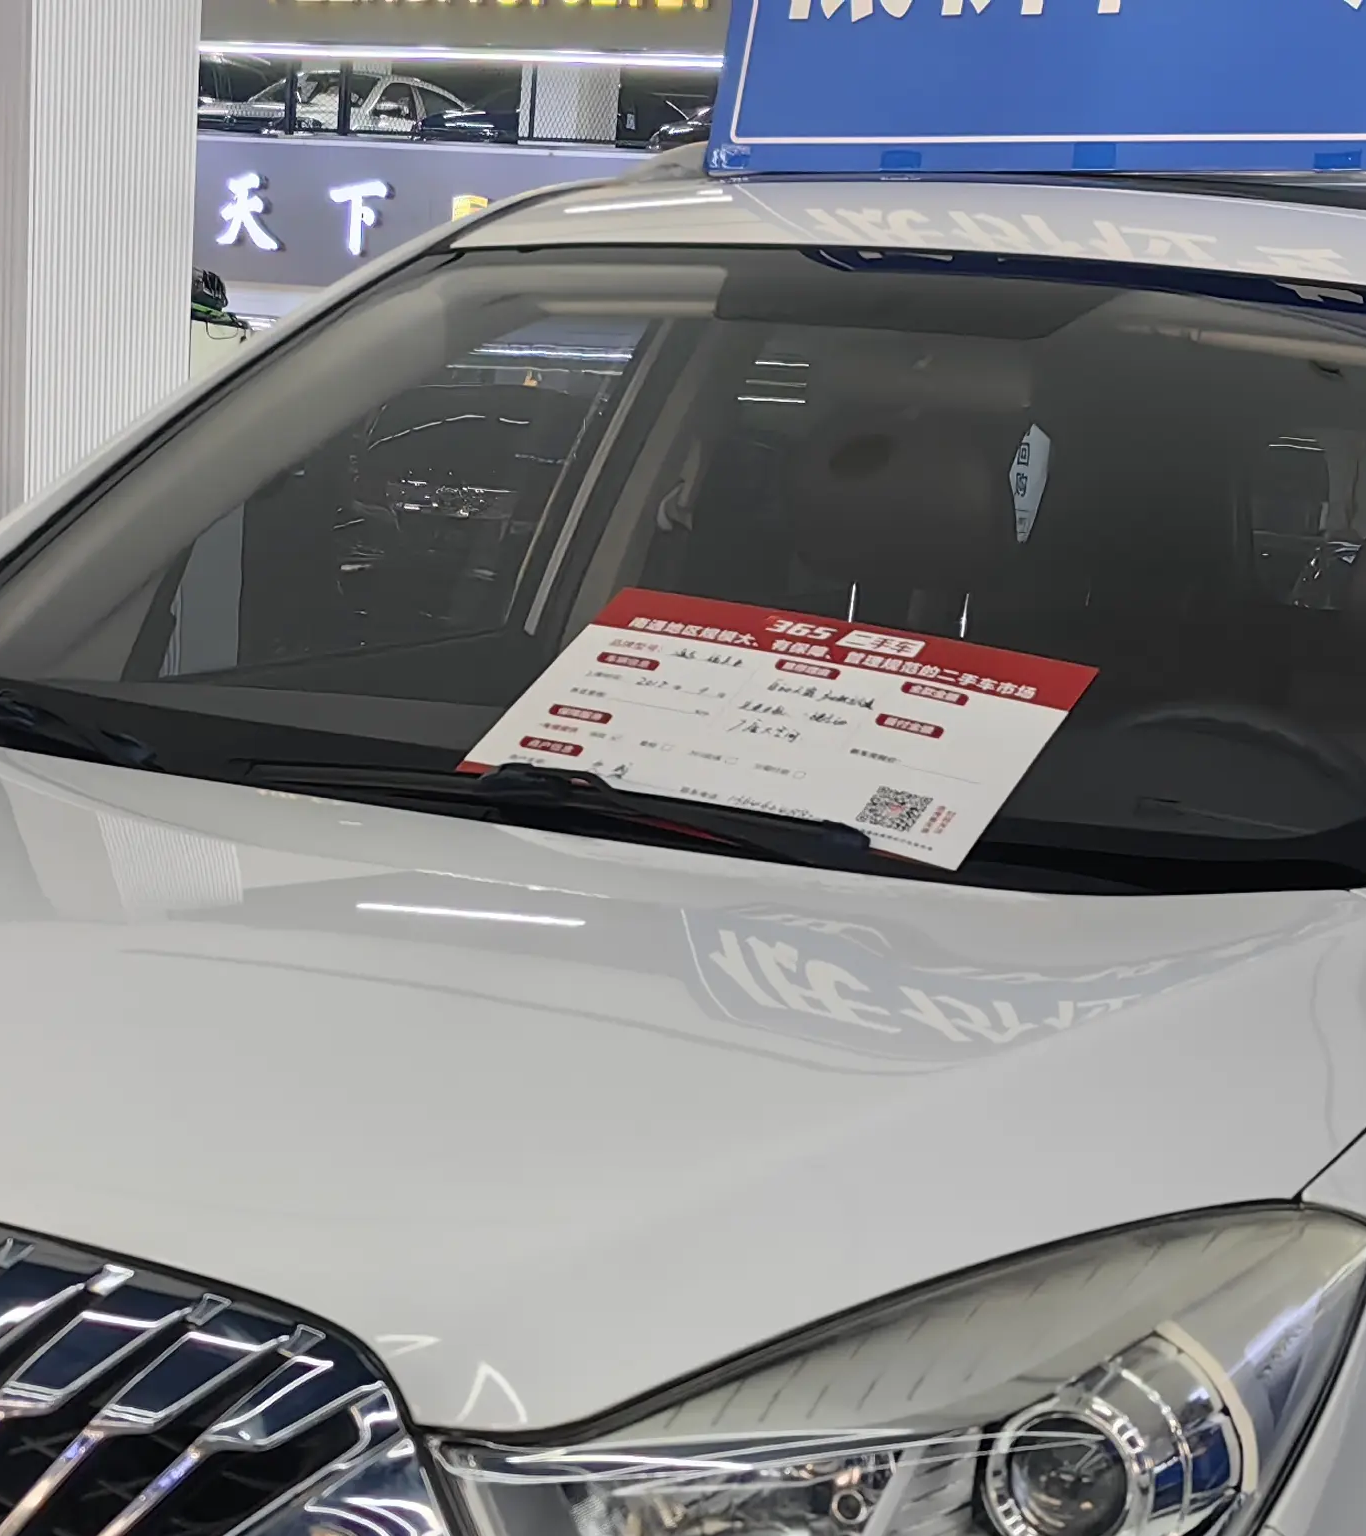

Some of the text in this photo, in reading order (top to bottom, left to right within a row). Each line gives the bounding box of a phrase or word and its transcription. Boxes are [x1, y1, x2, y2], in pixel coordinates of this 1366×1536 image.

[765, 618, 915, 655] 365 二手车
